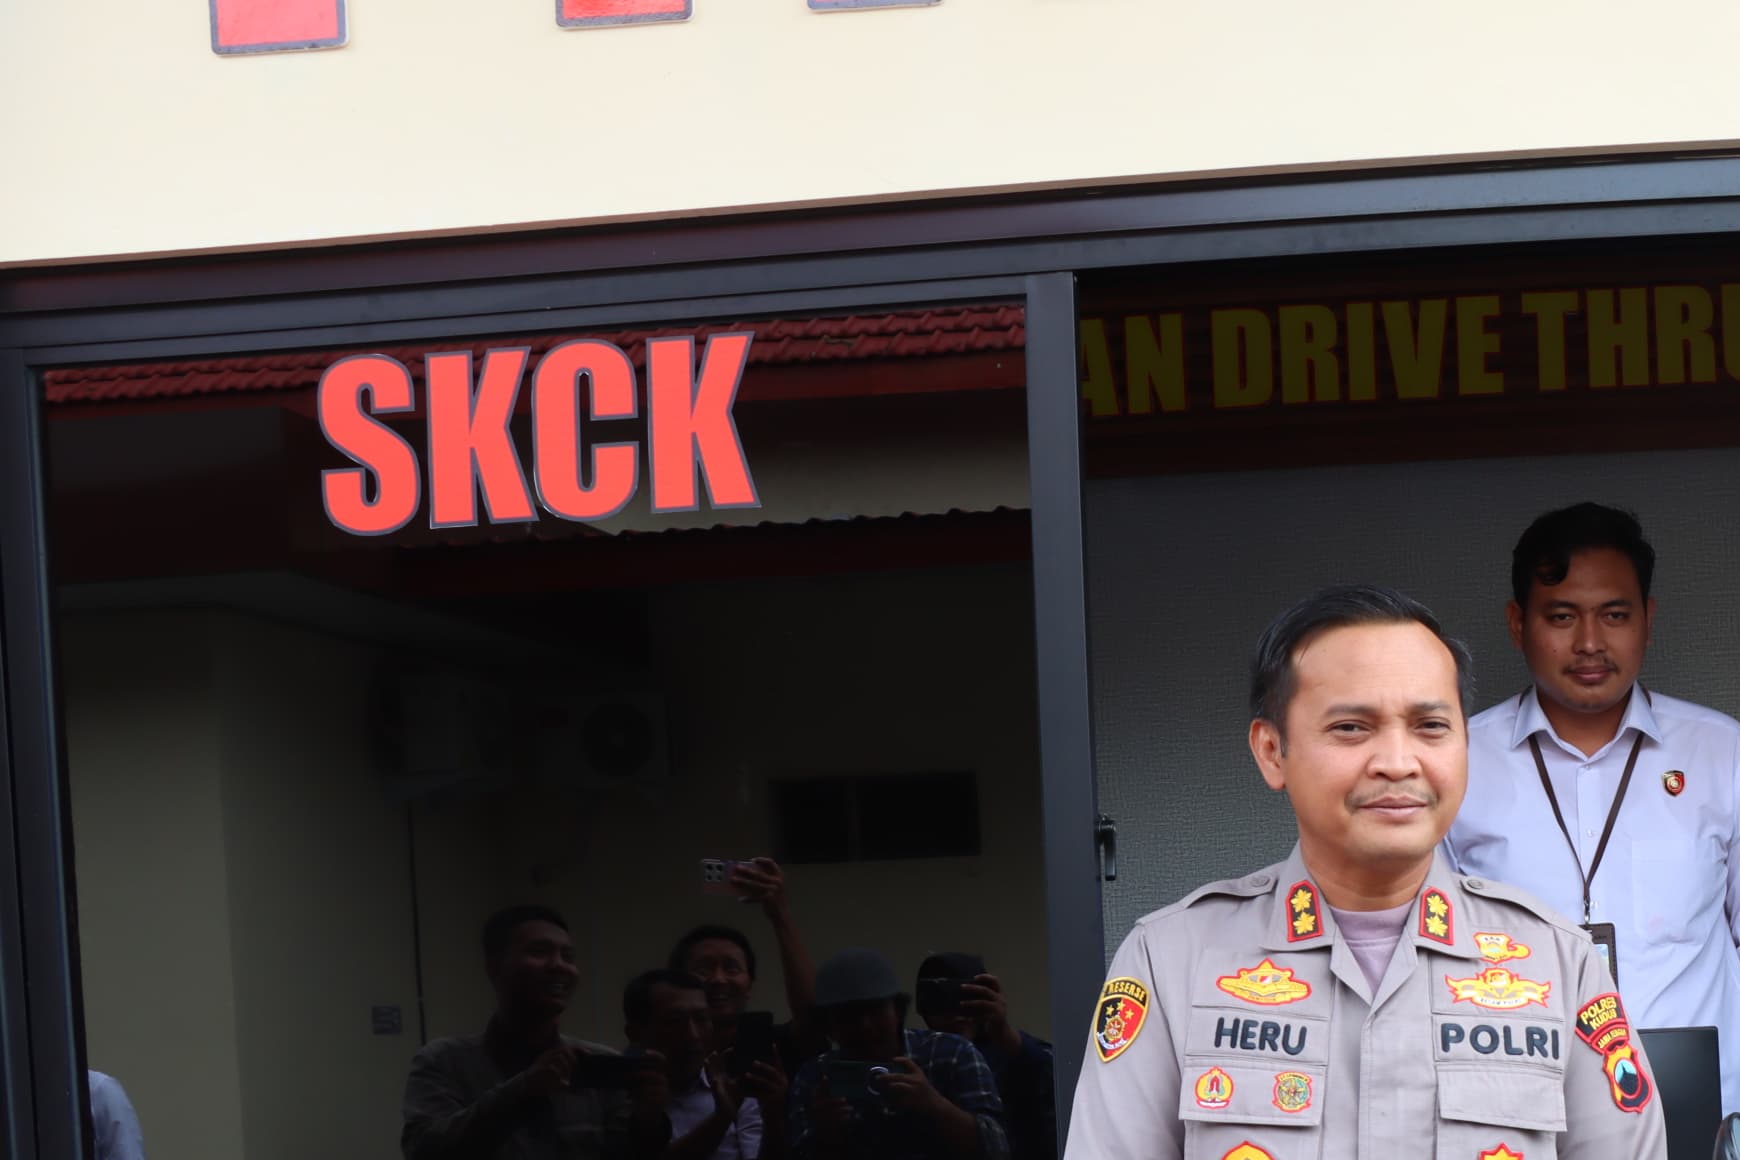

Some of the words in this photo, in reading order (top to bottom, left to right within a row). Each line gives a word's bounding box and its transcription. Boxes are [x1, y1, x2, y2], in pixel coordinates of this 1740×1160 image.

[1080, 312, 1187, 418] AN
[1211, 294, 1505, 408] DRIVE
[318, 331, 761, 536] SKCK
[1108, 981, 1146, 1001] RESERSE
[1580, 996, 1617, 1025] POLRES
[1589, 1008, 1617, 1030] KUDUS
[1214, 1017, 1307, 1056] HERU
[1441, 1022, 1560, 1060] POLRI
